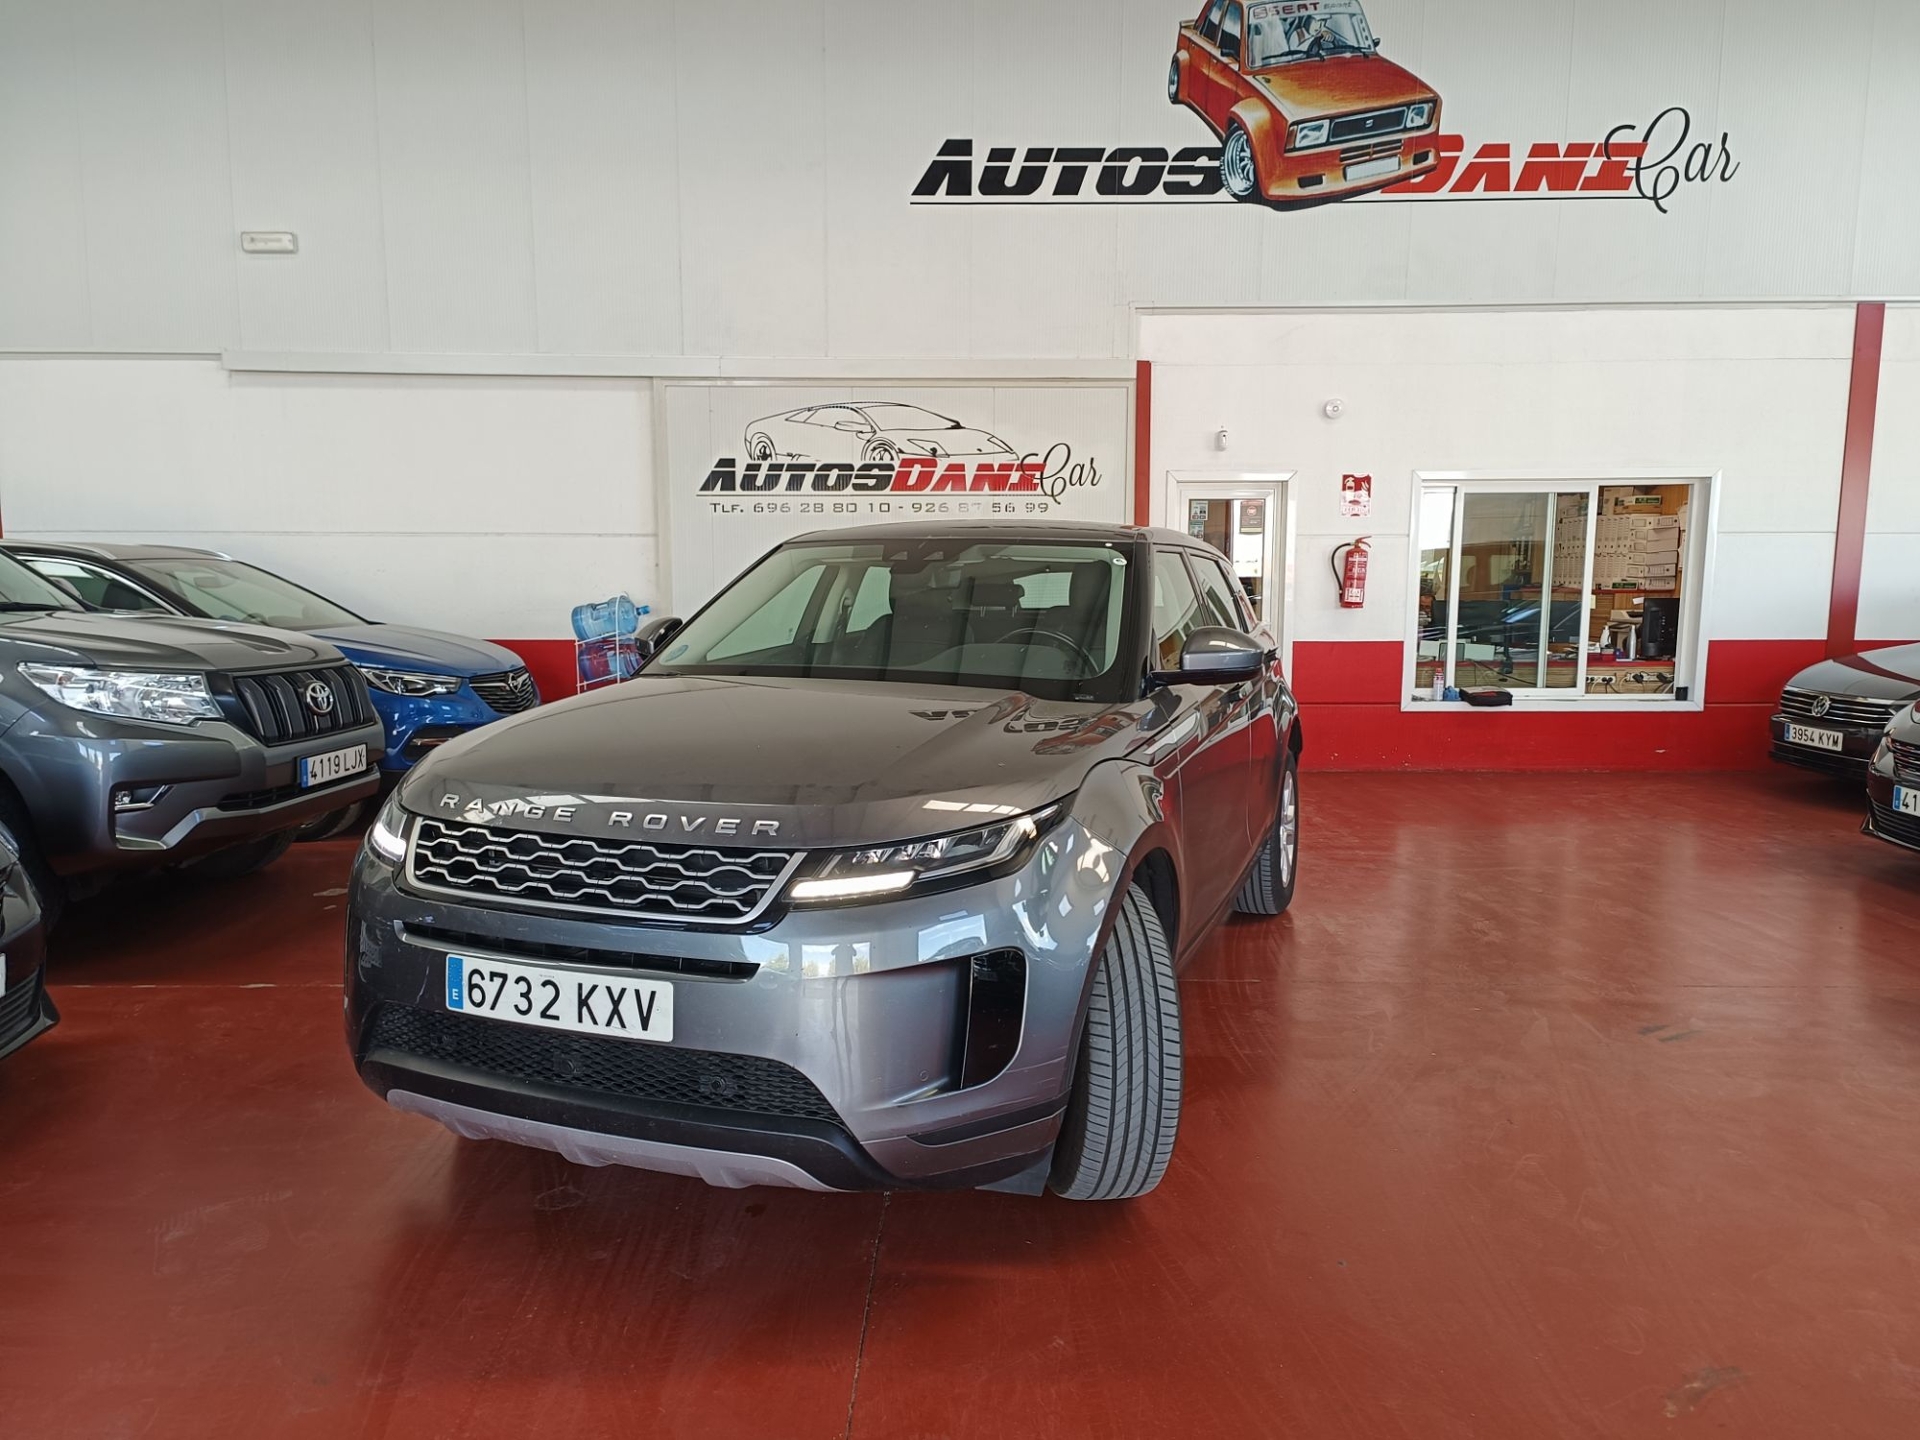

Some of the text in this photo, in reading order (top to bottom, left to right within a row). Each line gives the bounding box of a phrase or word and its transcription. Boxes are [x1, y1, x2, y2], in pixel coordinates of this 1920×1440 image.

[910, 138, 1226, 196] AUTOS
[1603, 106, 1741, 215] Car
[1020, 442, 1102, 505] Car
[753, 502, 791, 513] 696
[799, 502, 824, 513] 28
[832, 502, 858, 513] 80
[868, 502, 891, 513] 10
[911, 502, 949, 513] 926
[991, 502, 1016, 513] 56
[1025, 502, 1049, 513] 99
[1791, 727, 1840, 748] 3954 KYM
[310, 747, 364, 780] 4119 LJX
[439, 793, 782, 836] RANGE ROVER
[1901, 791, 1918, 812] 41
[452, 988, 459, 1000] E
[467, 967, 657, 1032] 6732 KXV
